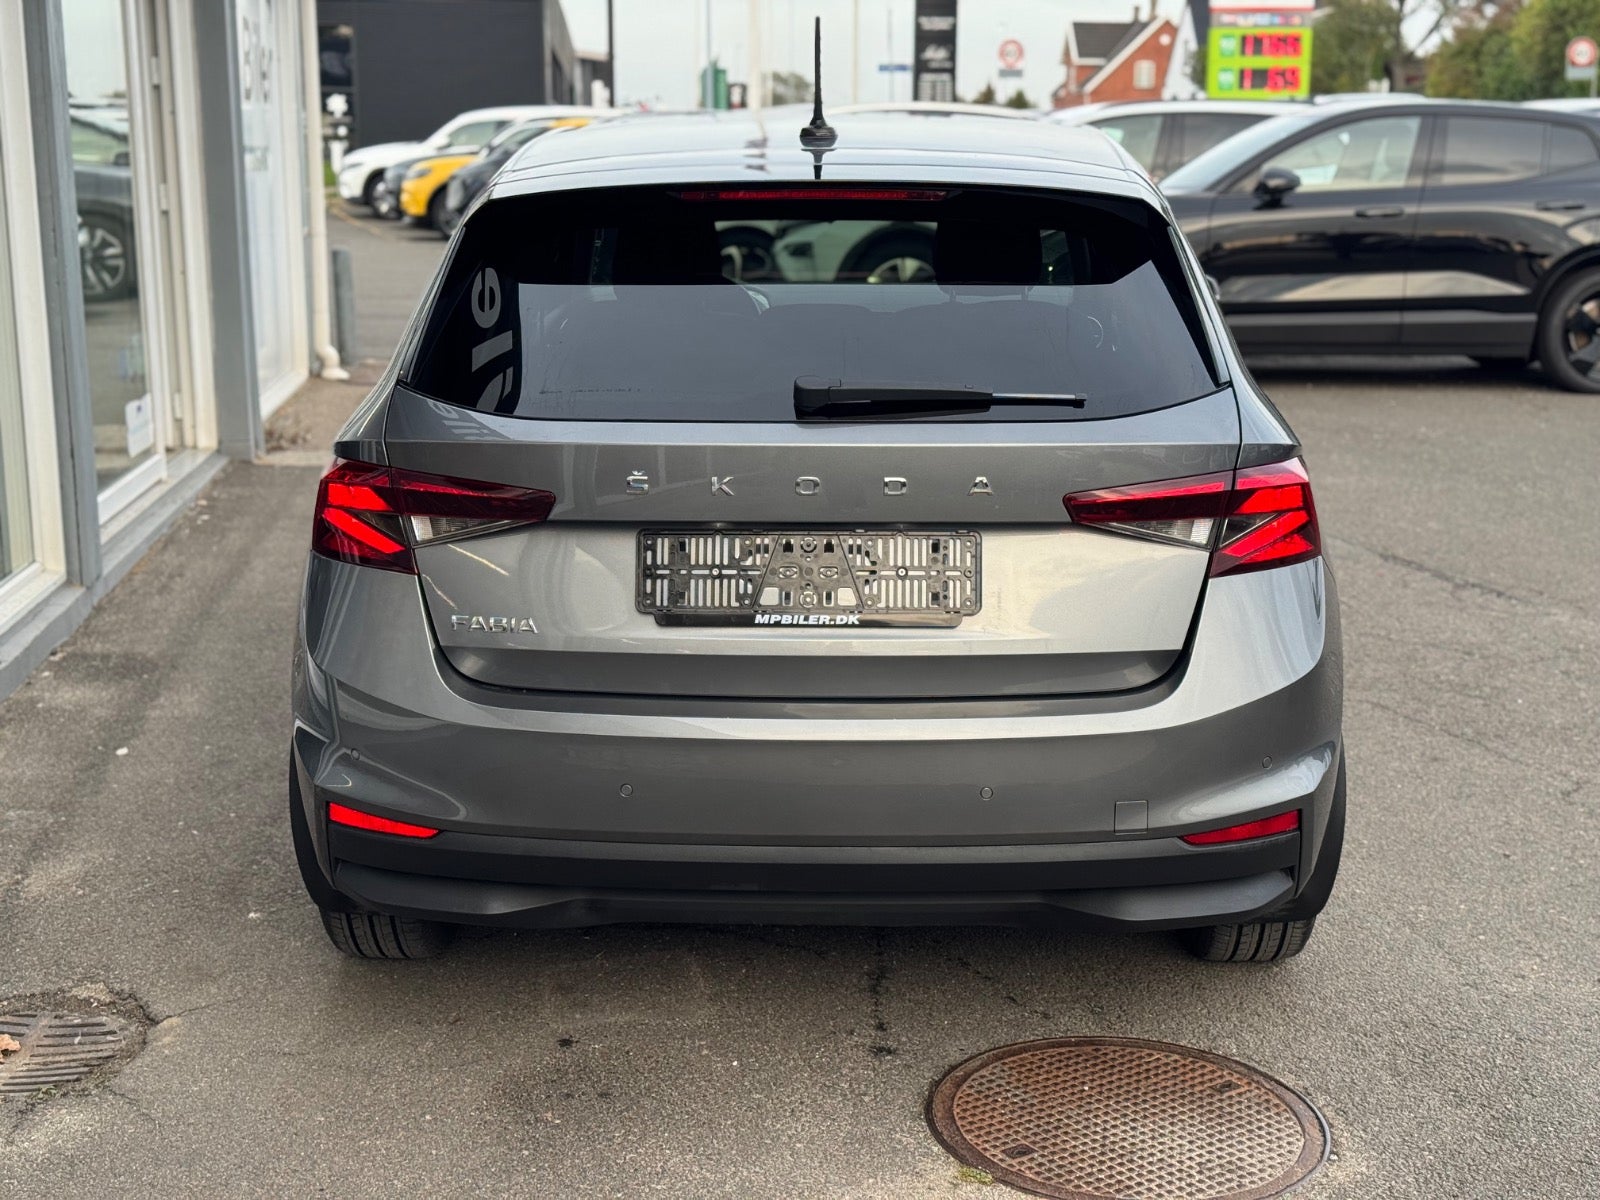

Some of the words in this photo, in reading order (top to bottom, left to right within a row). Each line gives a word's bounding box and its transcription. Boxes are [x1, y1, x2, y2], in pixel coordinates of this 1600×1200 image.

[625, 470, 994, 496] ŠKODA
[450, 614, 539, 634] FABIA
[754, 613, 861, 626] MPBILER.DK
